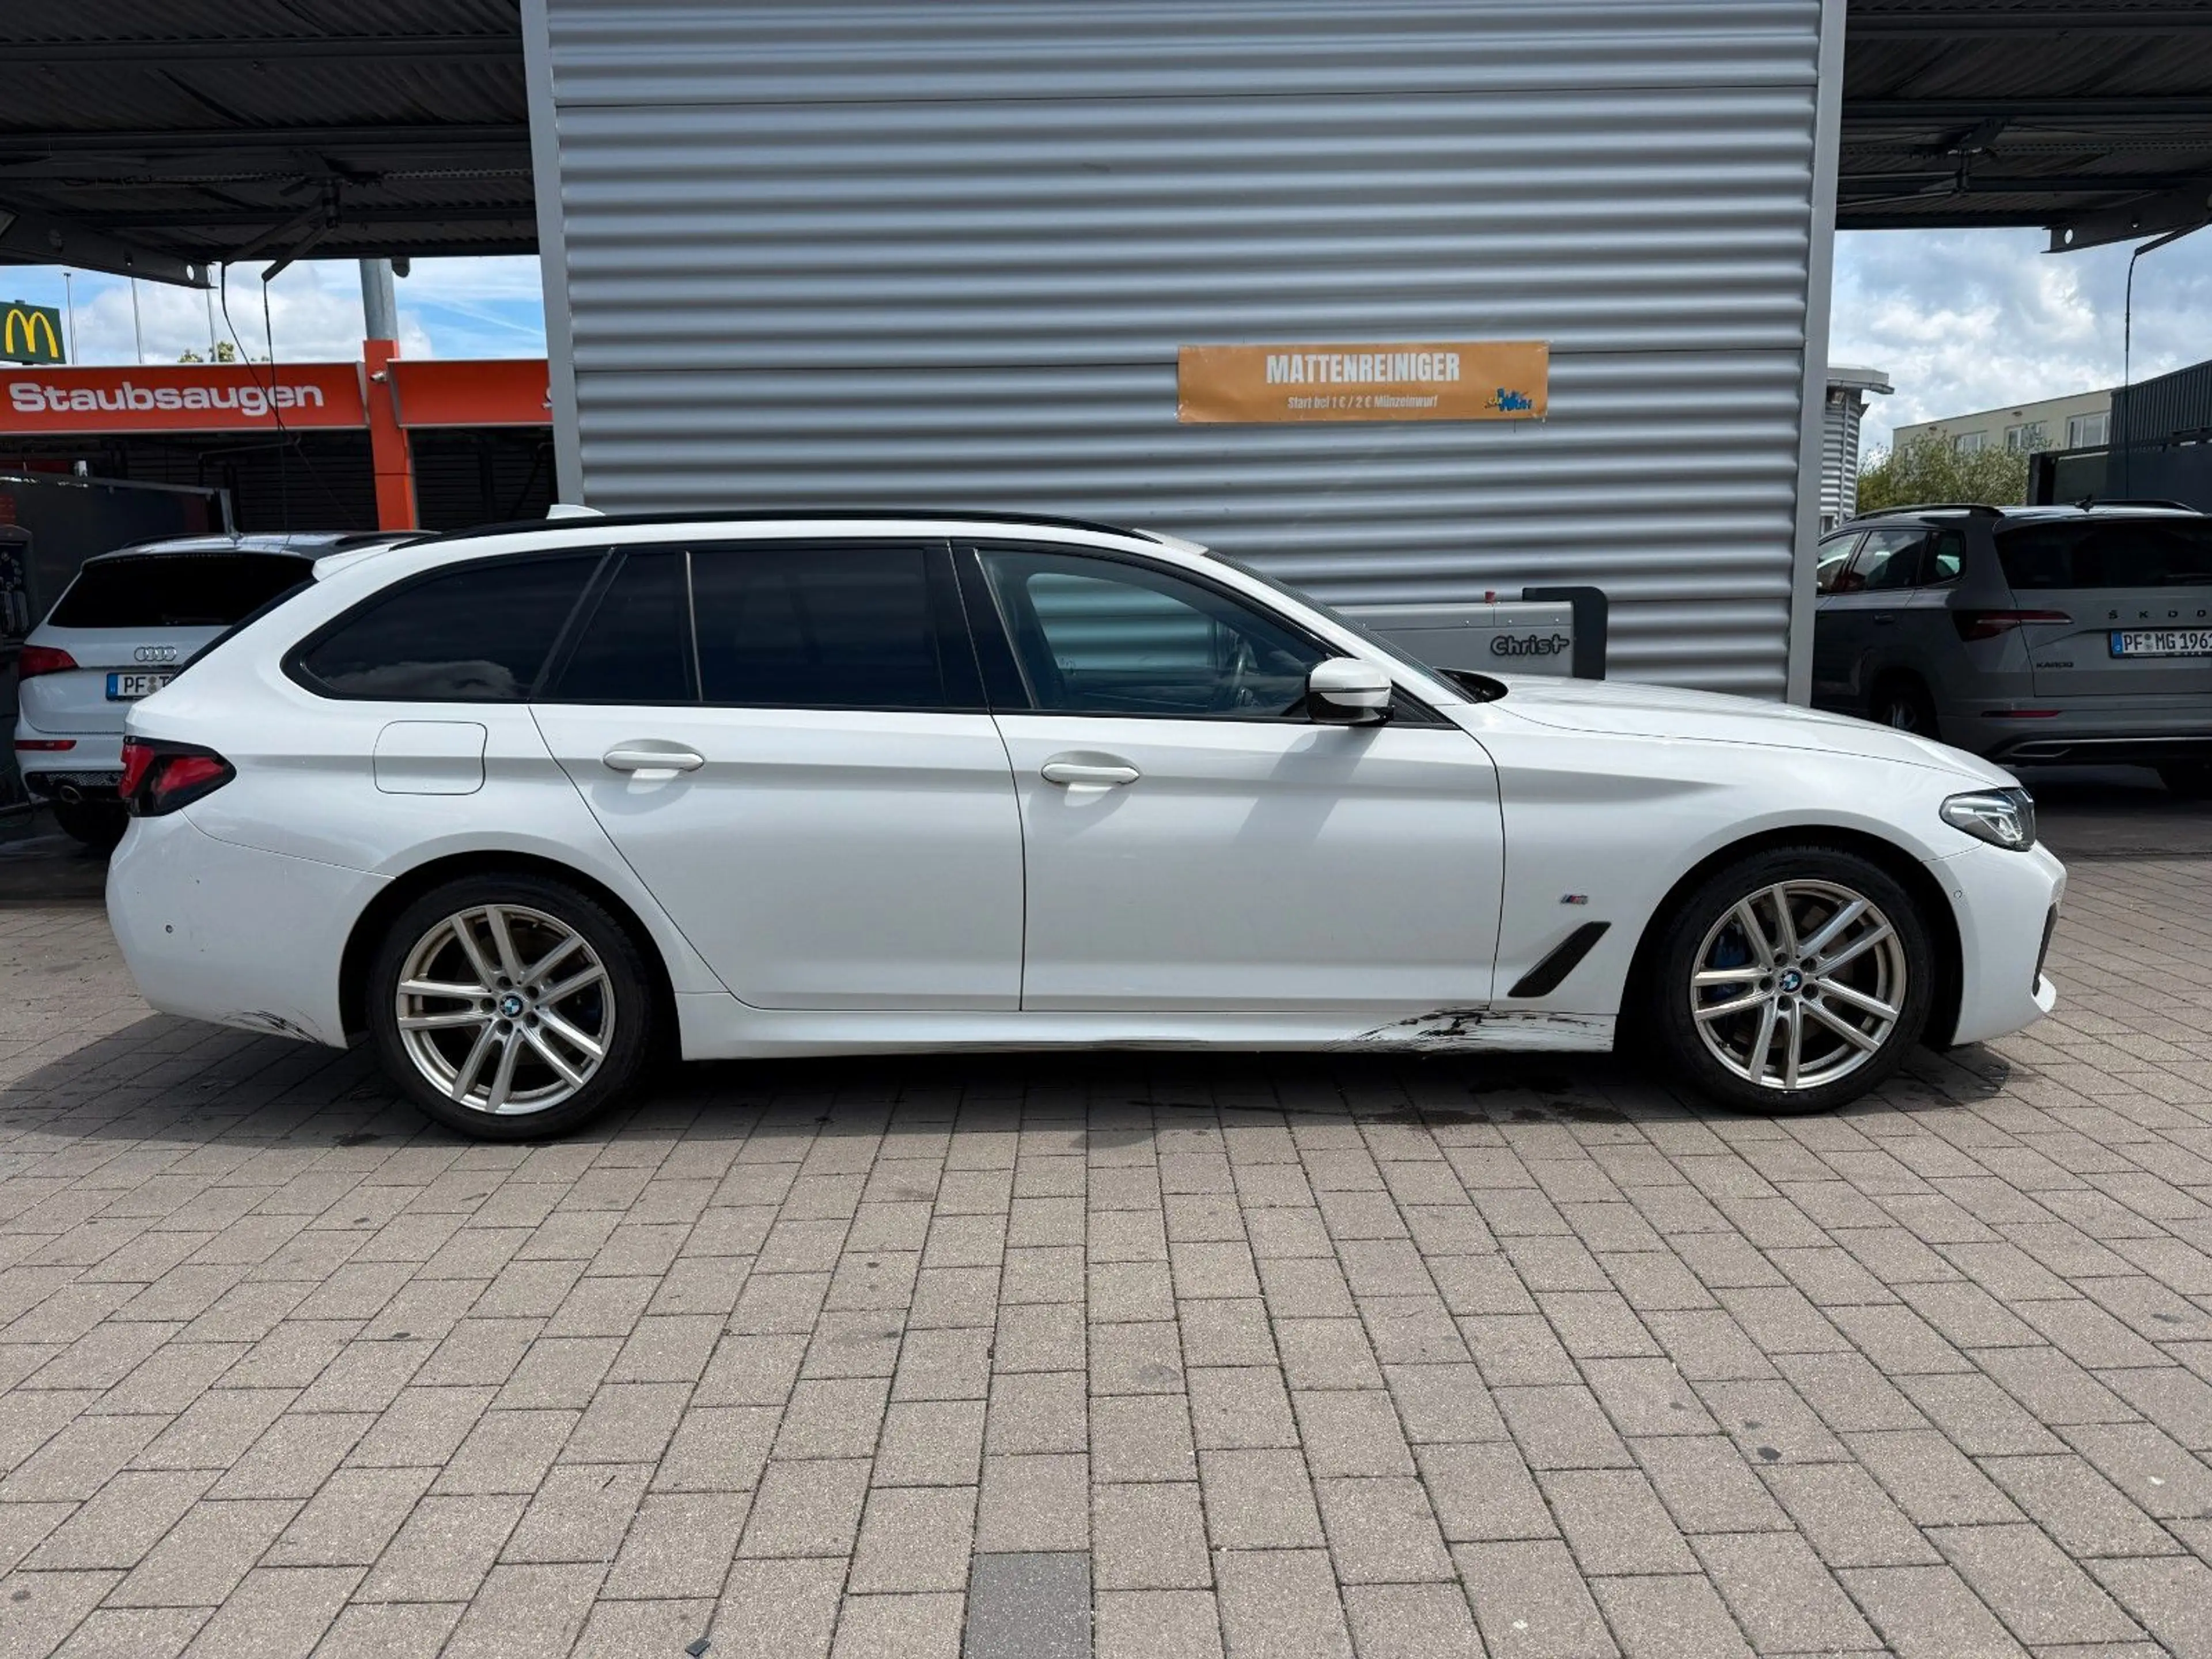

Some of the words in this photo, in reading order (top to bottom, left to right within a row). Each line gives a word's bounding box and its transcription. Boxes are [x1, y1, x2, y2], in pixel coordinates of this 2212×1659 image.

[1267, 353, 1460, 384] MATTENREINIGER
[9, 382, 324, 415] Staubsaugen
[1288, 396, 1312, 408] Start
[1315, 396, 1330, 408] bei
[1374, 395, 1438, 408] Münzeinwurf
[1490, 634, 1570, 656] Christ
[2123, 634, 2142, 650] PF
[2155, 633, 2176, 649] MG
[123, 676, 146, 693] PF
